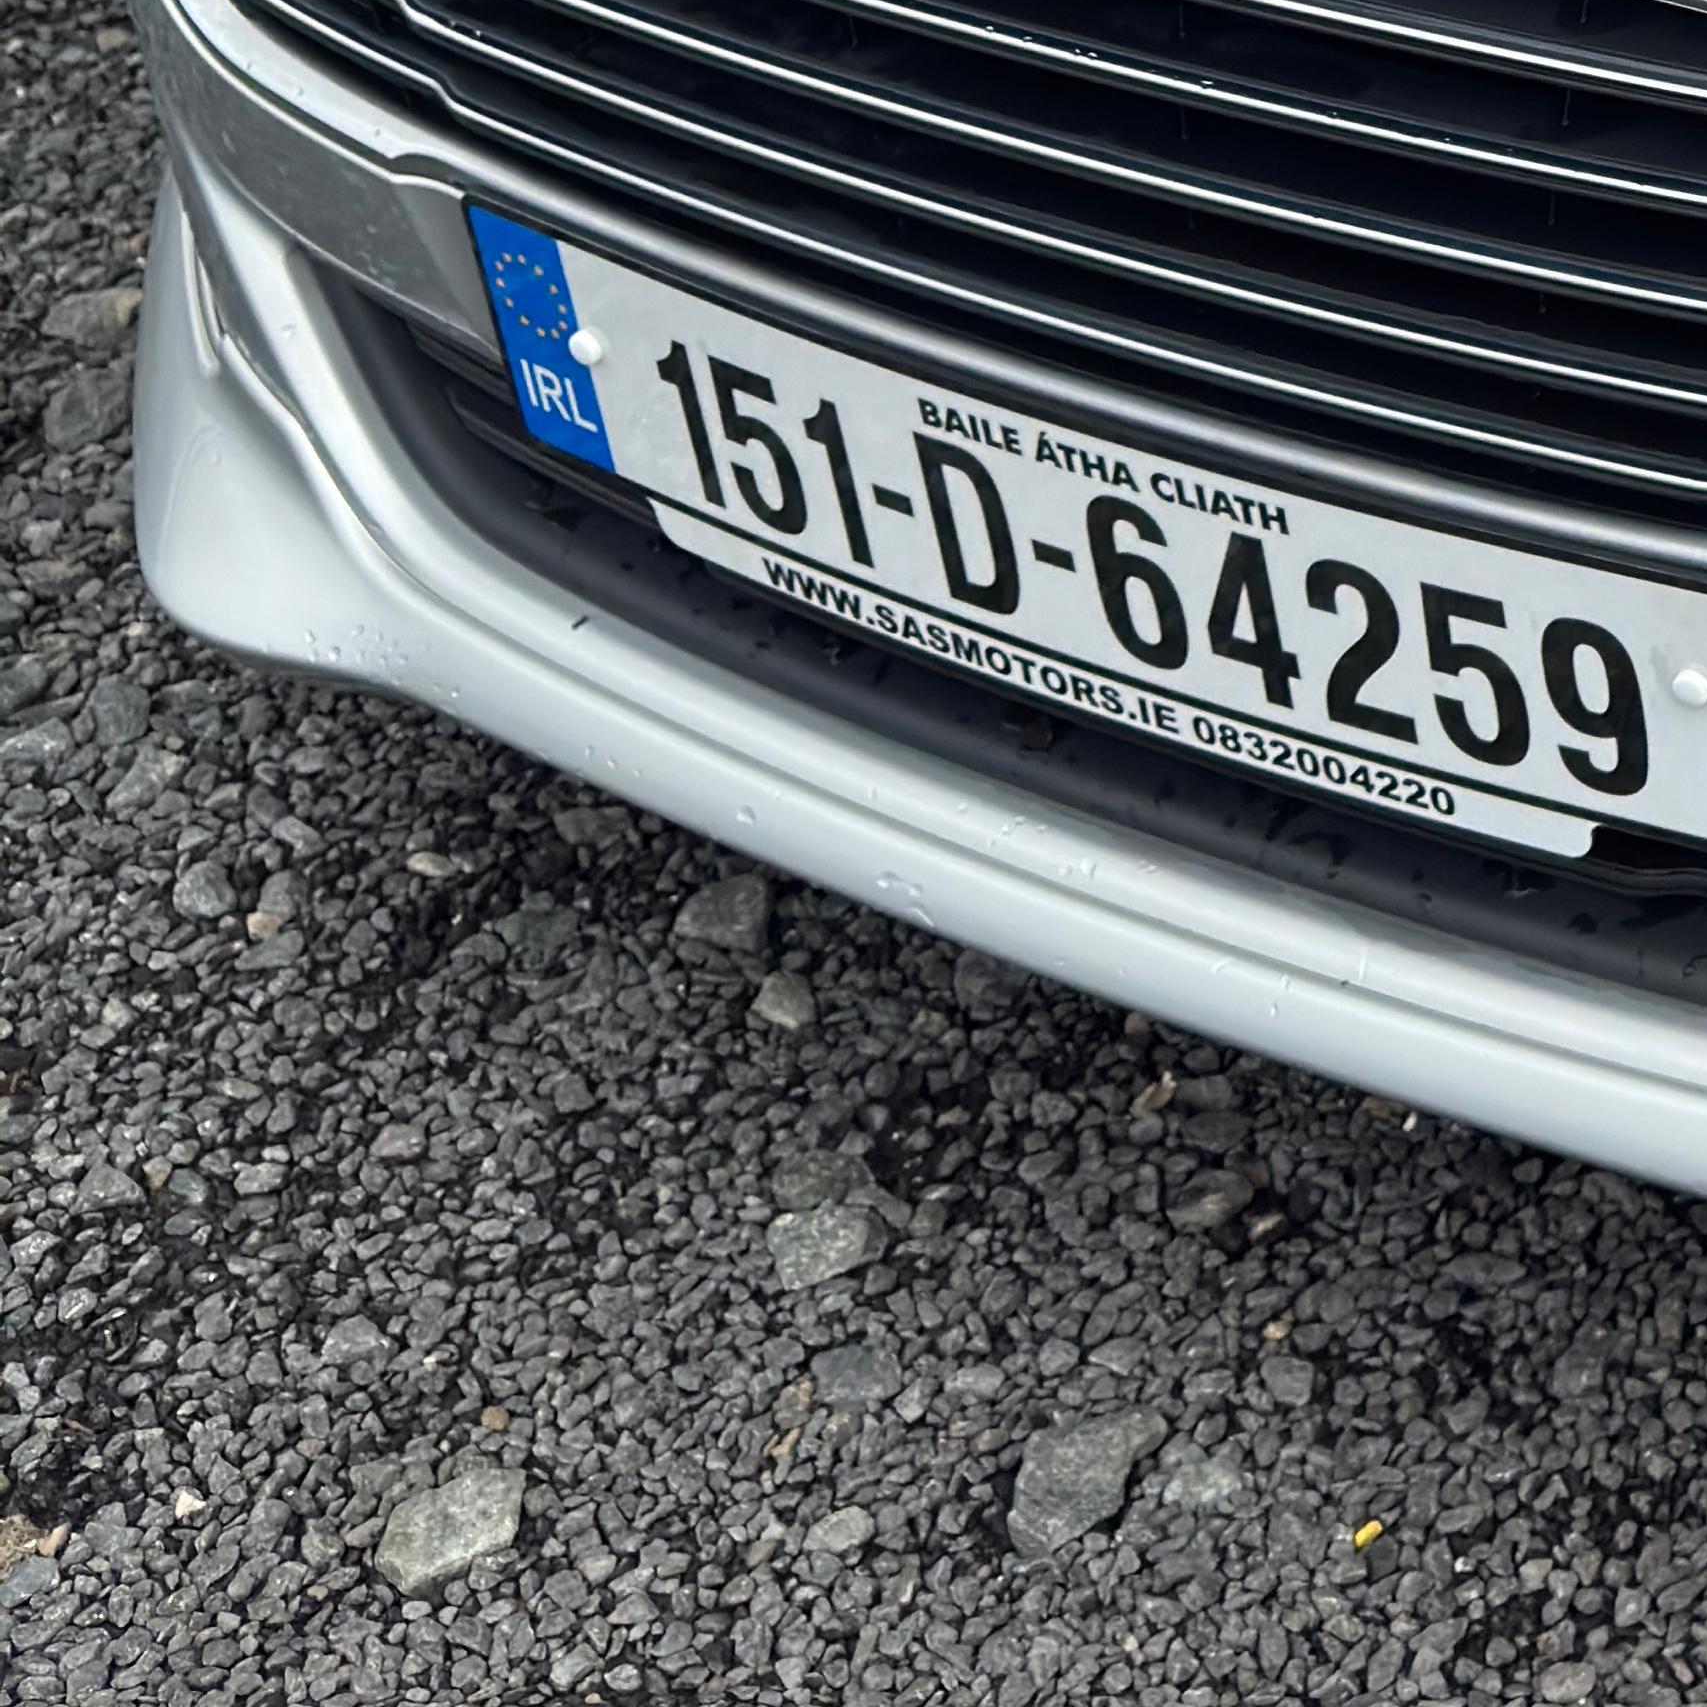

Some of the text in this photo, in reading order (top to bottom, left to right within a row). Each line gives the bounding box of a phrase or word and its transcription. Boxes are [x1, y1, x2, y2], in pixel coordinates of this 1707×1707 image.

[520, 358, 598, 434] IRL
[917, 398, 1289, 535] BAILE ÁTHA CLIATH
[656, 340, 1648, 795] 151-D-64259
[762, 557, 1455, 815] WWW.SASMOTORS.IE 0832004220
